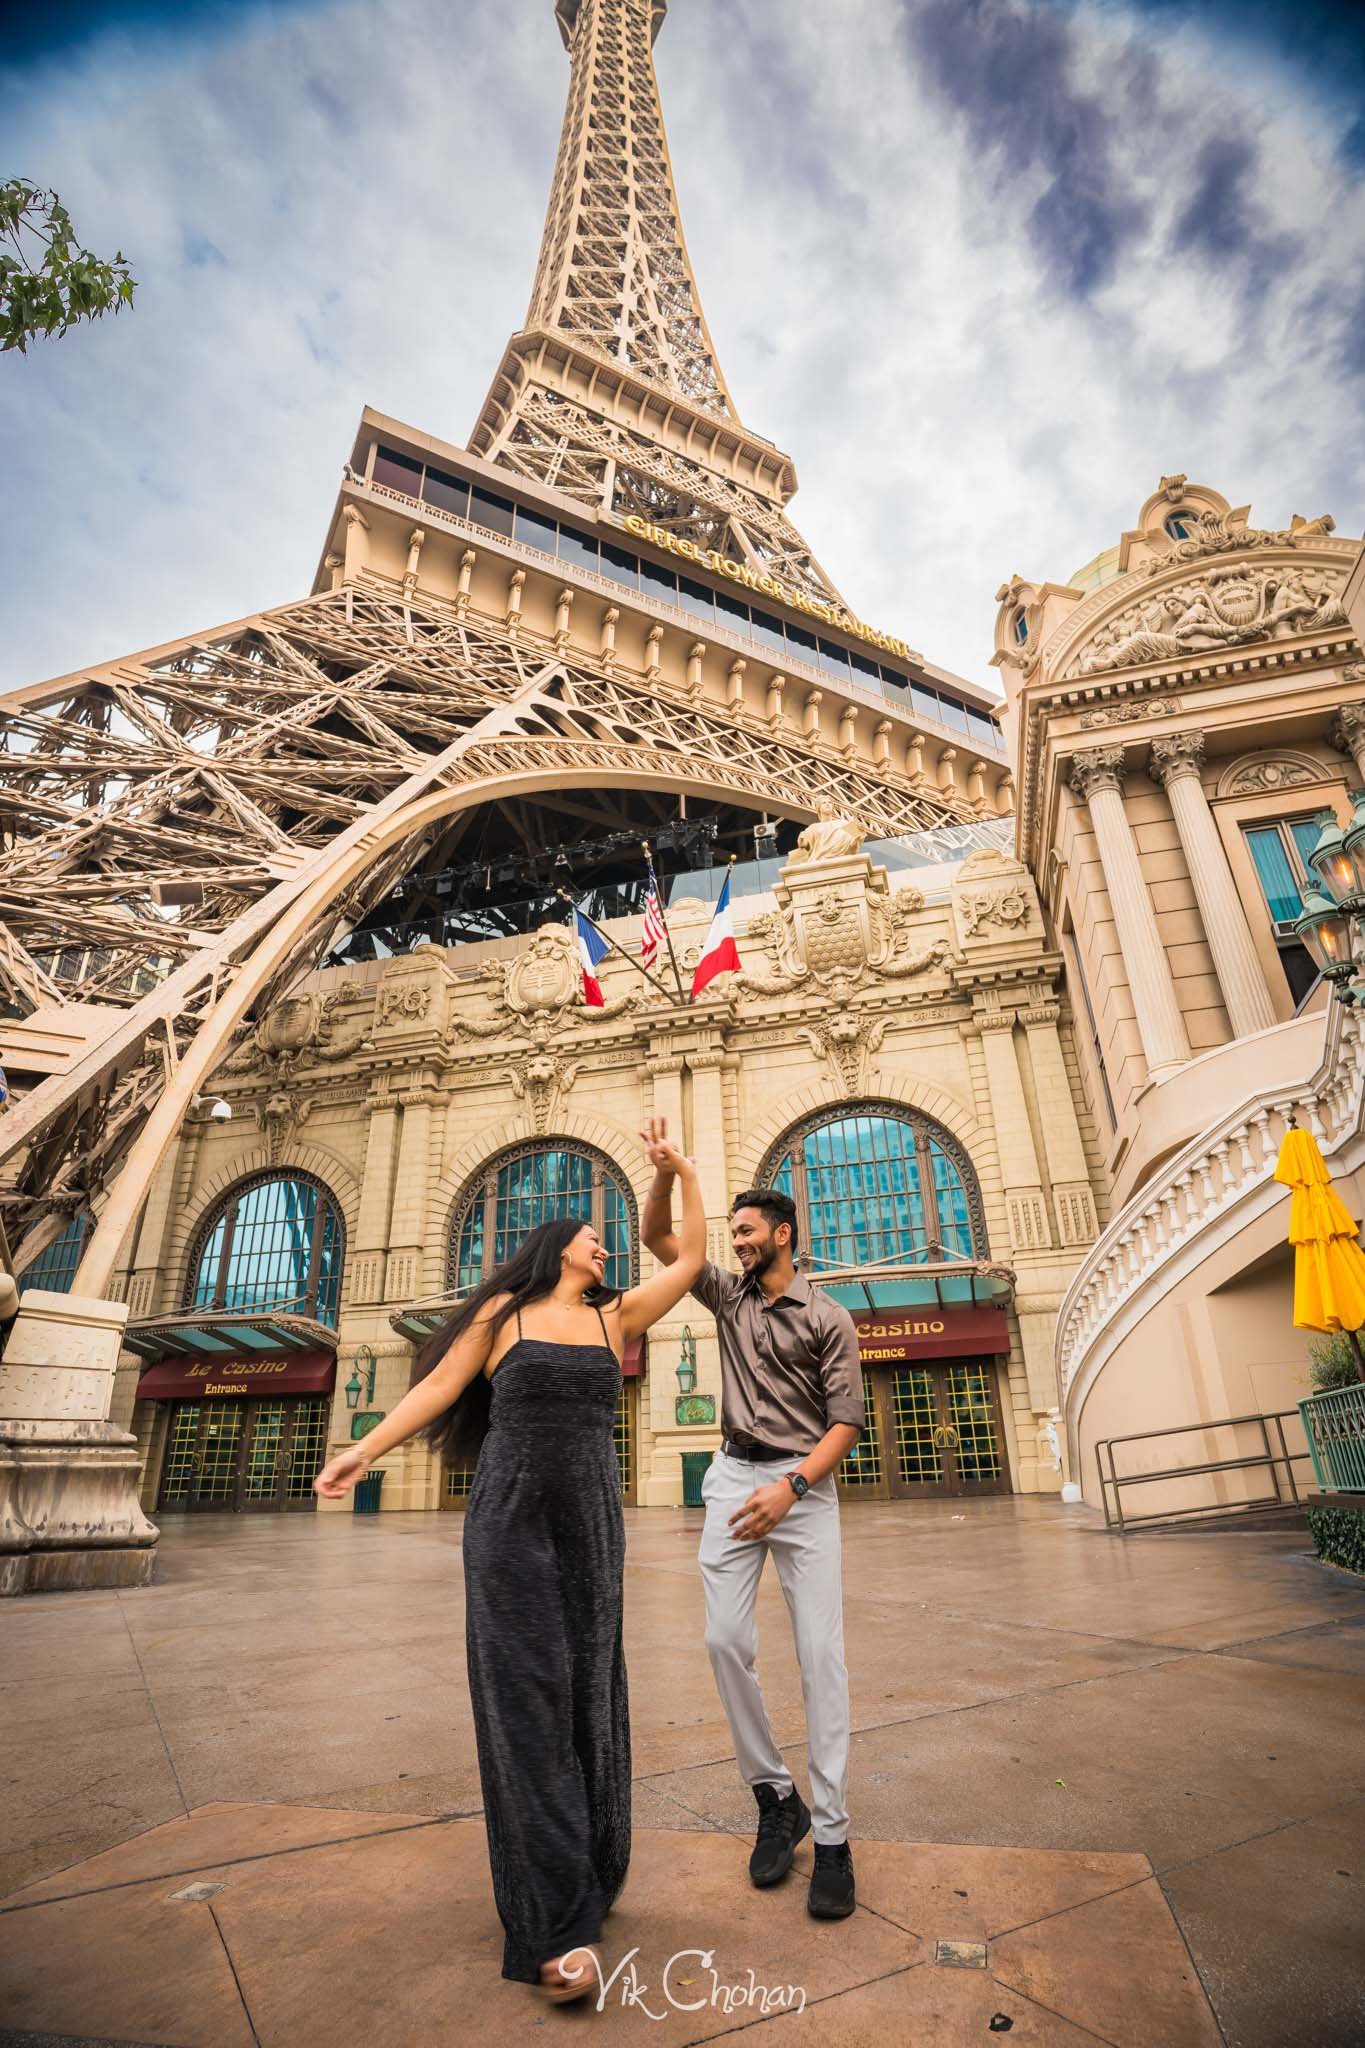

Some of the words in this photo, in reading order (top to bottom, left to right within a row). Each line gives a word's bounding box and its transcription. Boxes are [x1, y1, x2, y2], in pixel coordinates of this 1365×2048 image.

[624, 515, 704, 565] EIFFEL
[707, 550, 785, 599] TOWER
[793, 590, 909, 657] RESTAURANT
[598, 1051, 634, 1064] ANGERS
[857, 1320, 945, 1338] Casino
[859, 1348, 906, 1360] trance
[185, 1362, 212, 1377] Le
[222, 1359, 288, 1376] Casino
[204, 1383, 247, 1395] Entrance
